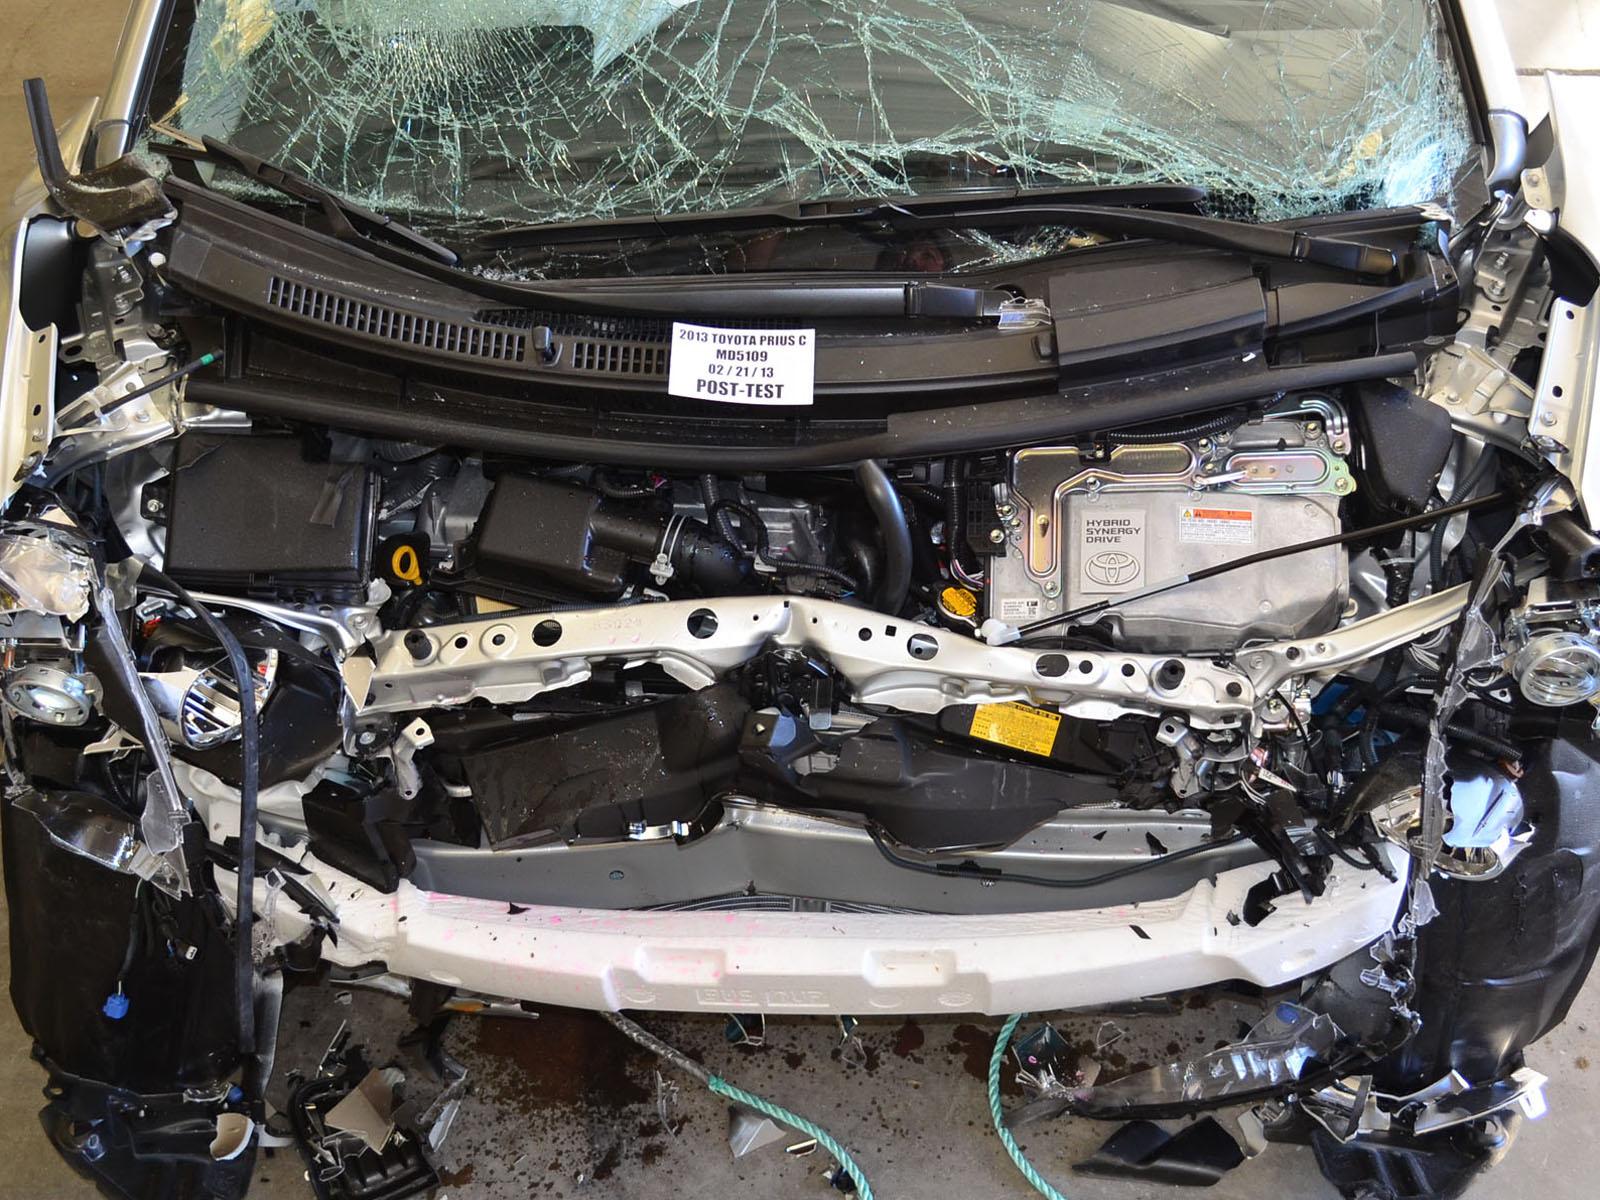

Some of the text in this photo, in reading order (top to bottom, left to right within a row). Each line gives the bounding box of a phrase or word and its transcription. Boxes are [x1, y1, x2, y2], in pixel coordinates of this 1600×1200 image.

[679, 329, 807, 346] 2013 TOYOTA PRIUS C
[696, 379, 784, 399] POST-TEST
[1086, 519, 1131, 527] HYBRID
[1086, 527, 1141, 535] SYNERGY
